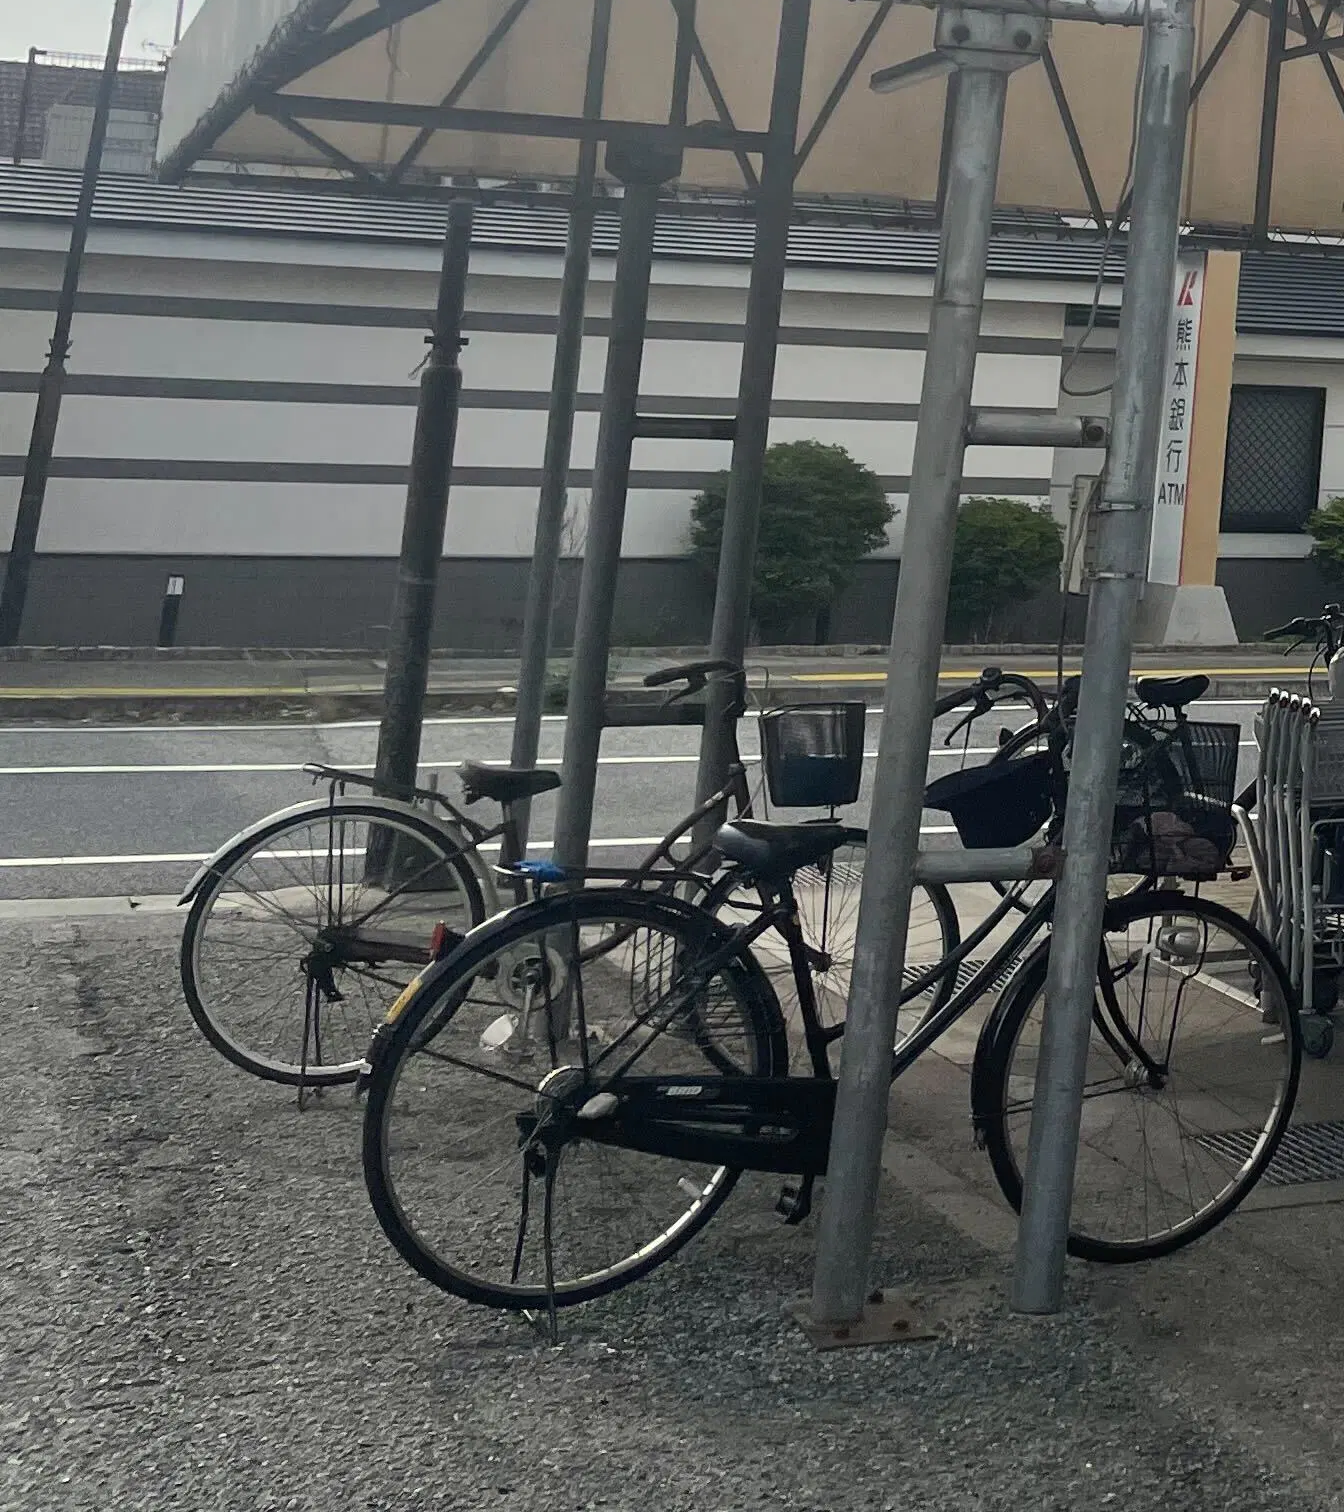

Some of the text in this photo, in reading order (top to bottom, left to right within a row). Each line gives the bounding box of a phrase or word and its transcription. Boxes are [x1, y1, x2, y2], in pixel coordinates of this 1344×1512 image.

[1167, 318, 1193, 474] 熊本銀行
[1158, 482, 1185, 506] ATM
